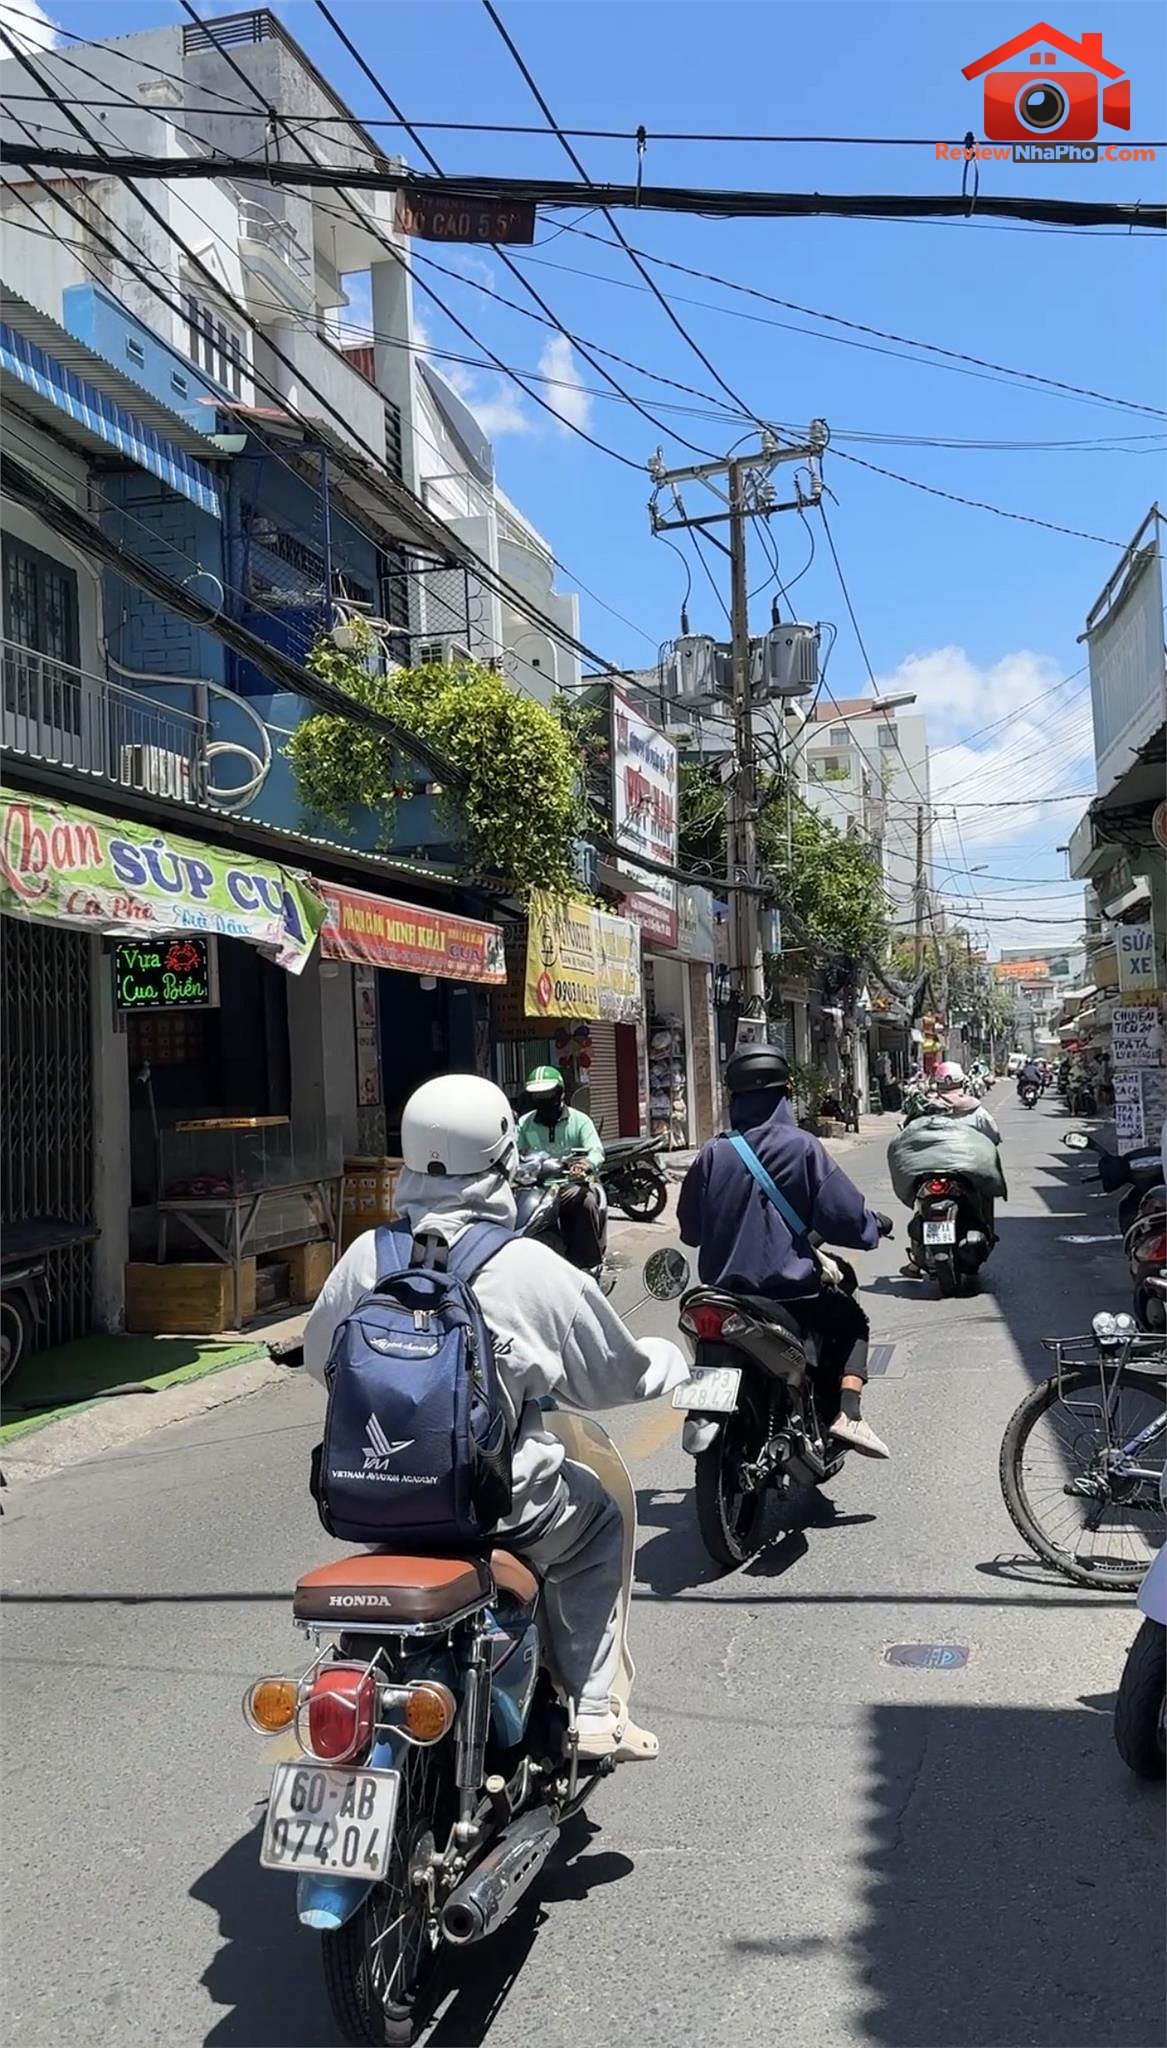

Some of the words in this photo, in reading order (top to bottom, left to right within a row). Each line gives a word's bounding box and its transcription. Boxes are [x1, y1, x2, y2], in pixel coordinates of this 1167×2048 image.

[432, 212, 470, 236] CAO
[122, 950, 161, 972] Vựa
[447, 943, 483, 962] CUA
[1130, 957, 1152, 975] XE
[122, 975, 158, 1001] Cua
[162, 972, 205, 999] Biển
[332, 1470, 365, 1479] VIETNAM
[366, 1472, 399, 1482] AVIATION
[401, 1475, 438, 1484] ACADEMY
[329, 1595, 391, 1607] HONDA
[290, 1771, 377, 1820] 60-AB
[271, 1818, 380, 1870] 074.04
